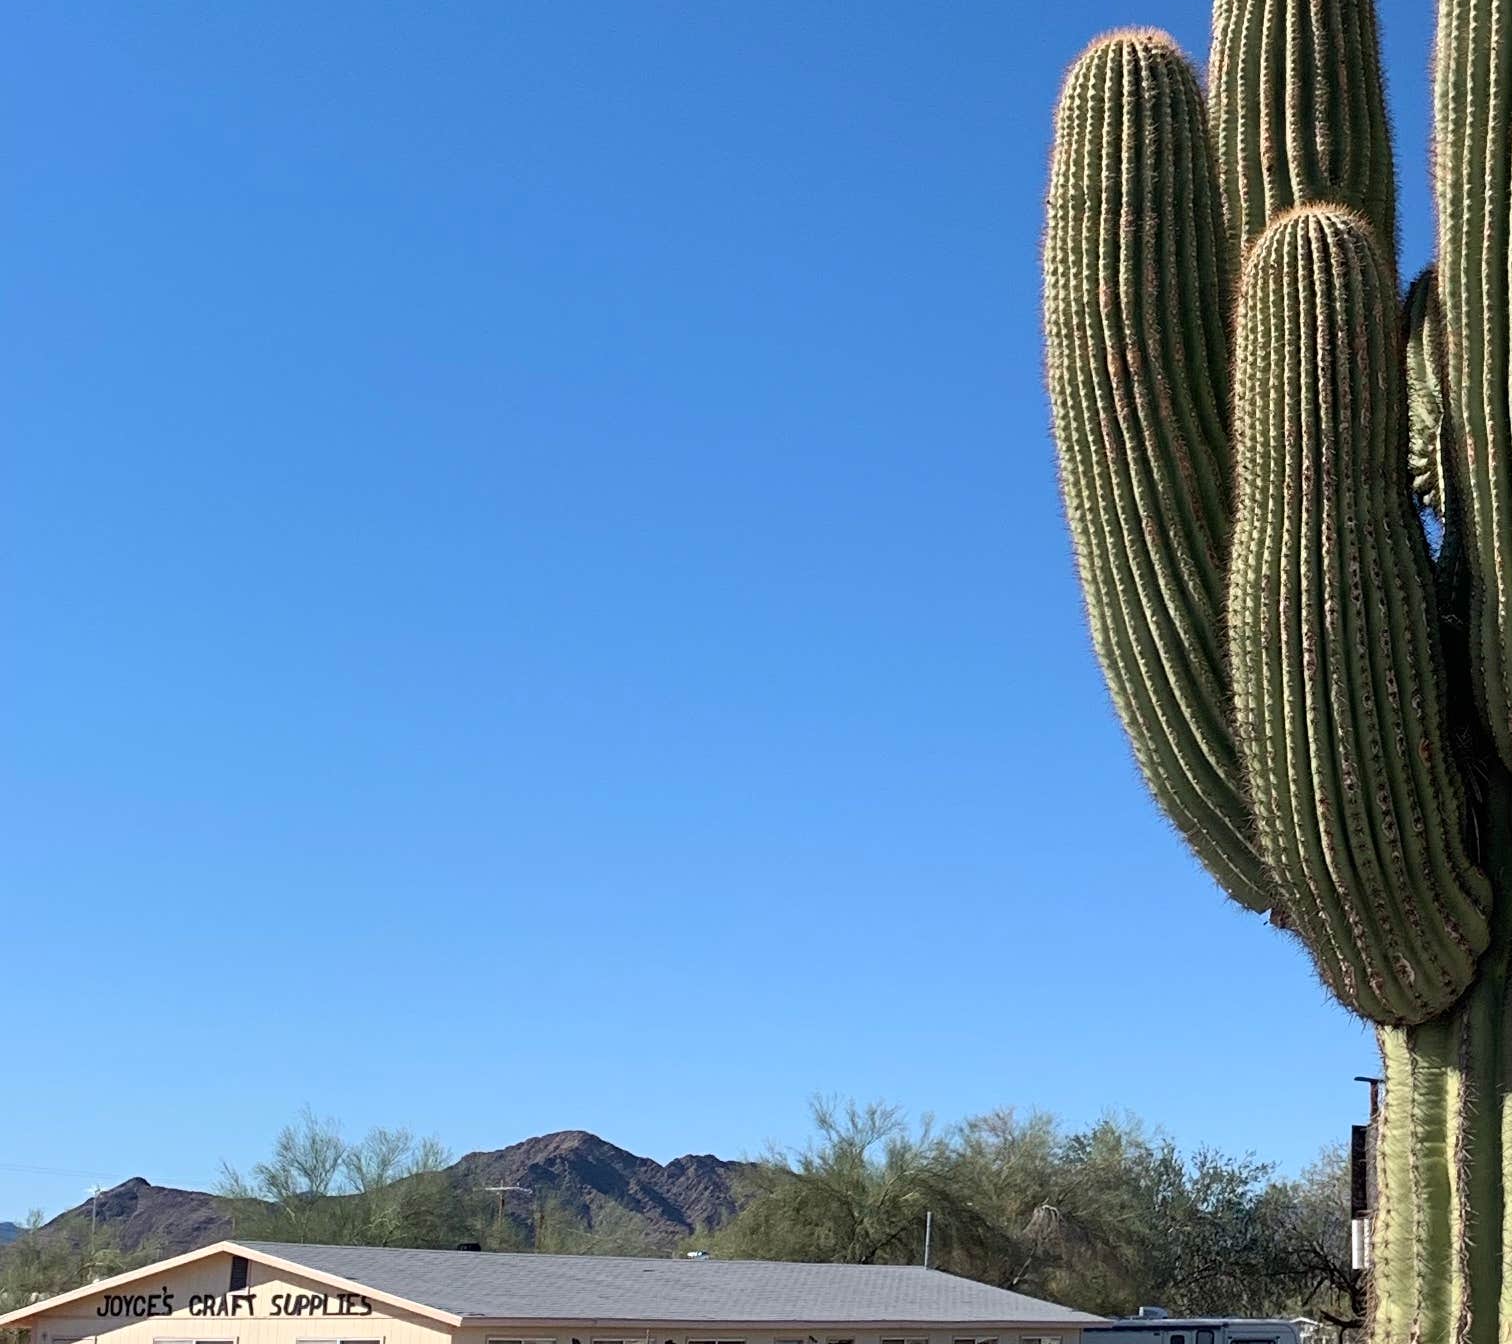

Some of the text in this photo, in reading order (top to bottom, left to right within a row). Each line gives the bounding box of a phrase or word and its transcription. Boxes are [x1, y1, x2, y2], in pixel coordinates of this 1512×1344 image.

[97, 1286, 372, 1317] JOYCE'S CRAFT SUPPLIES
